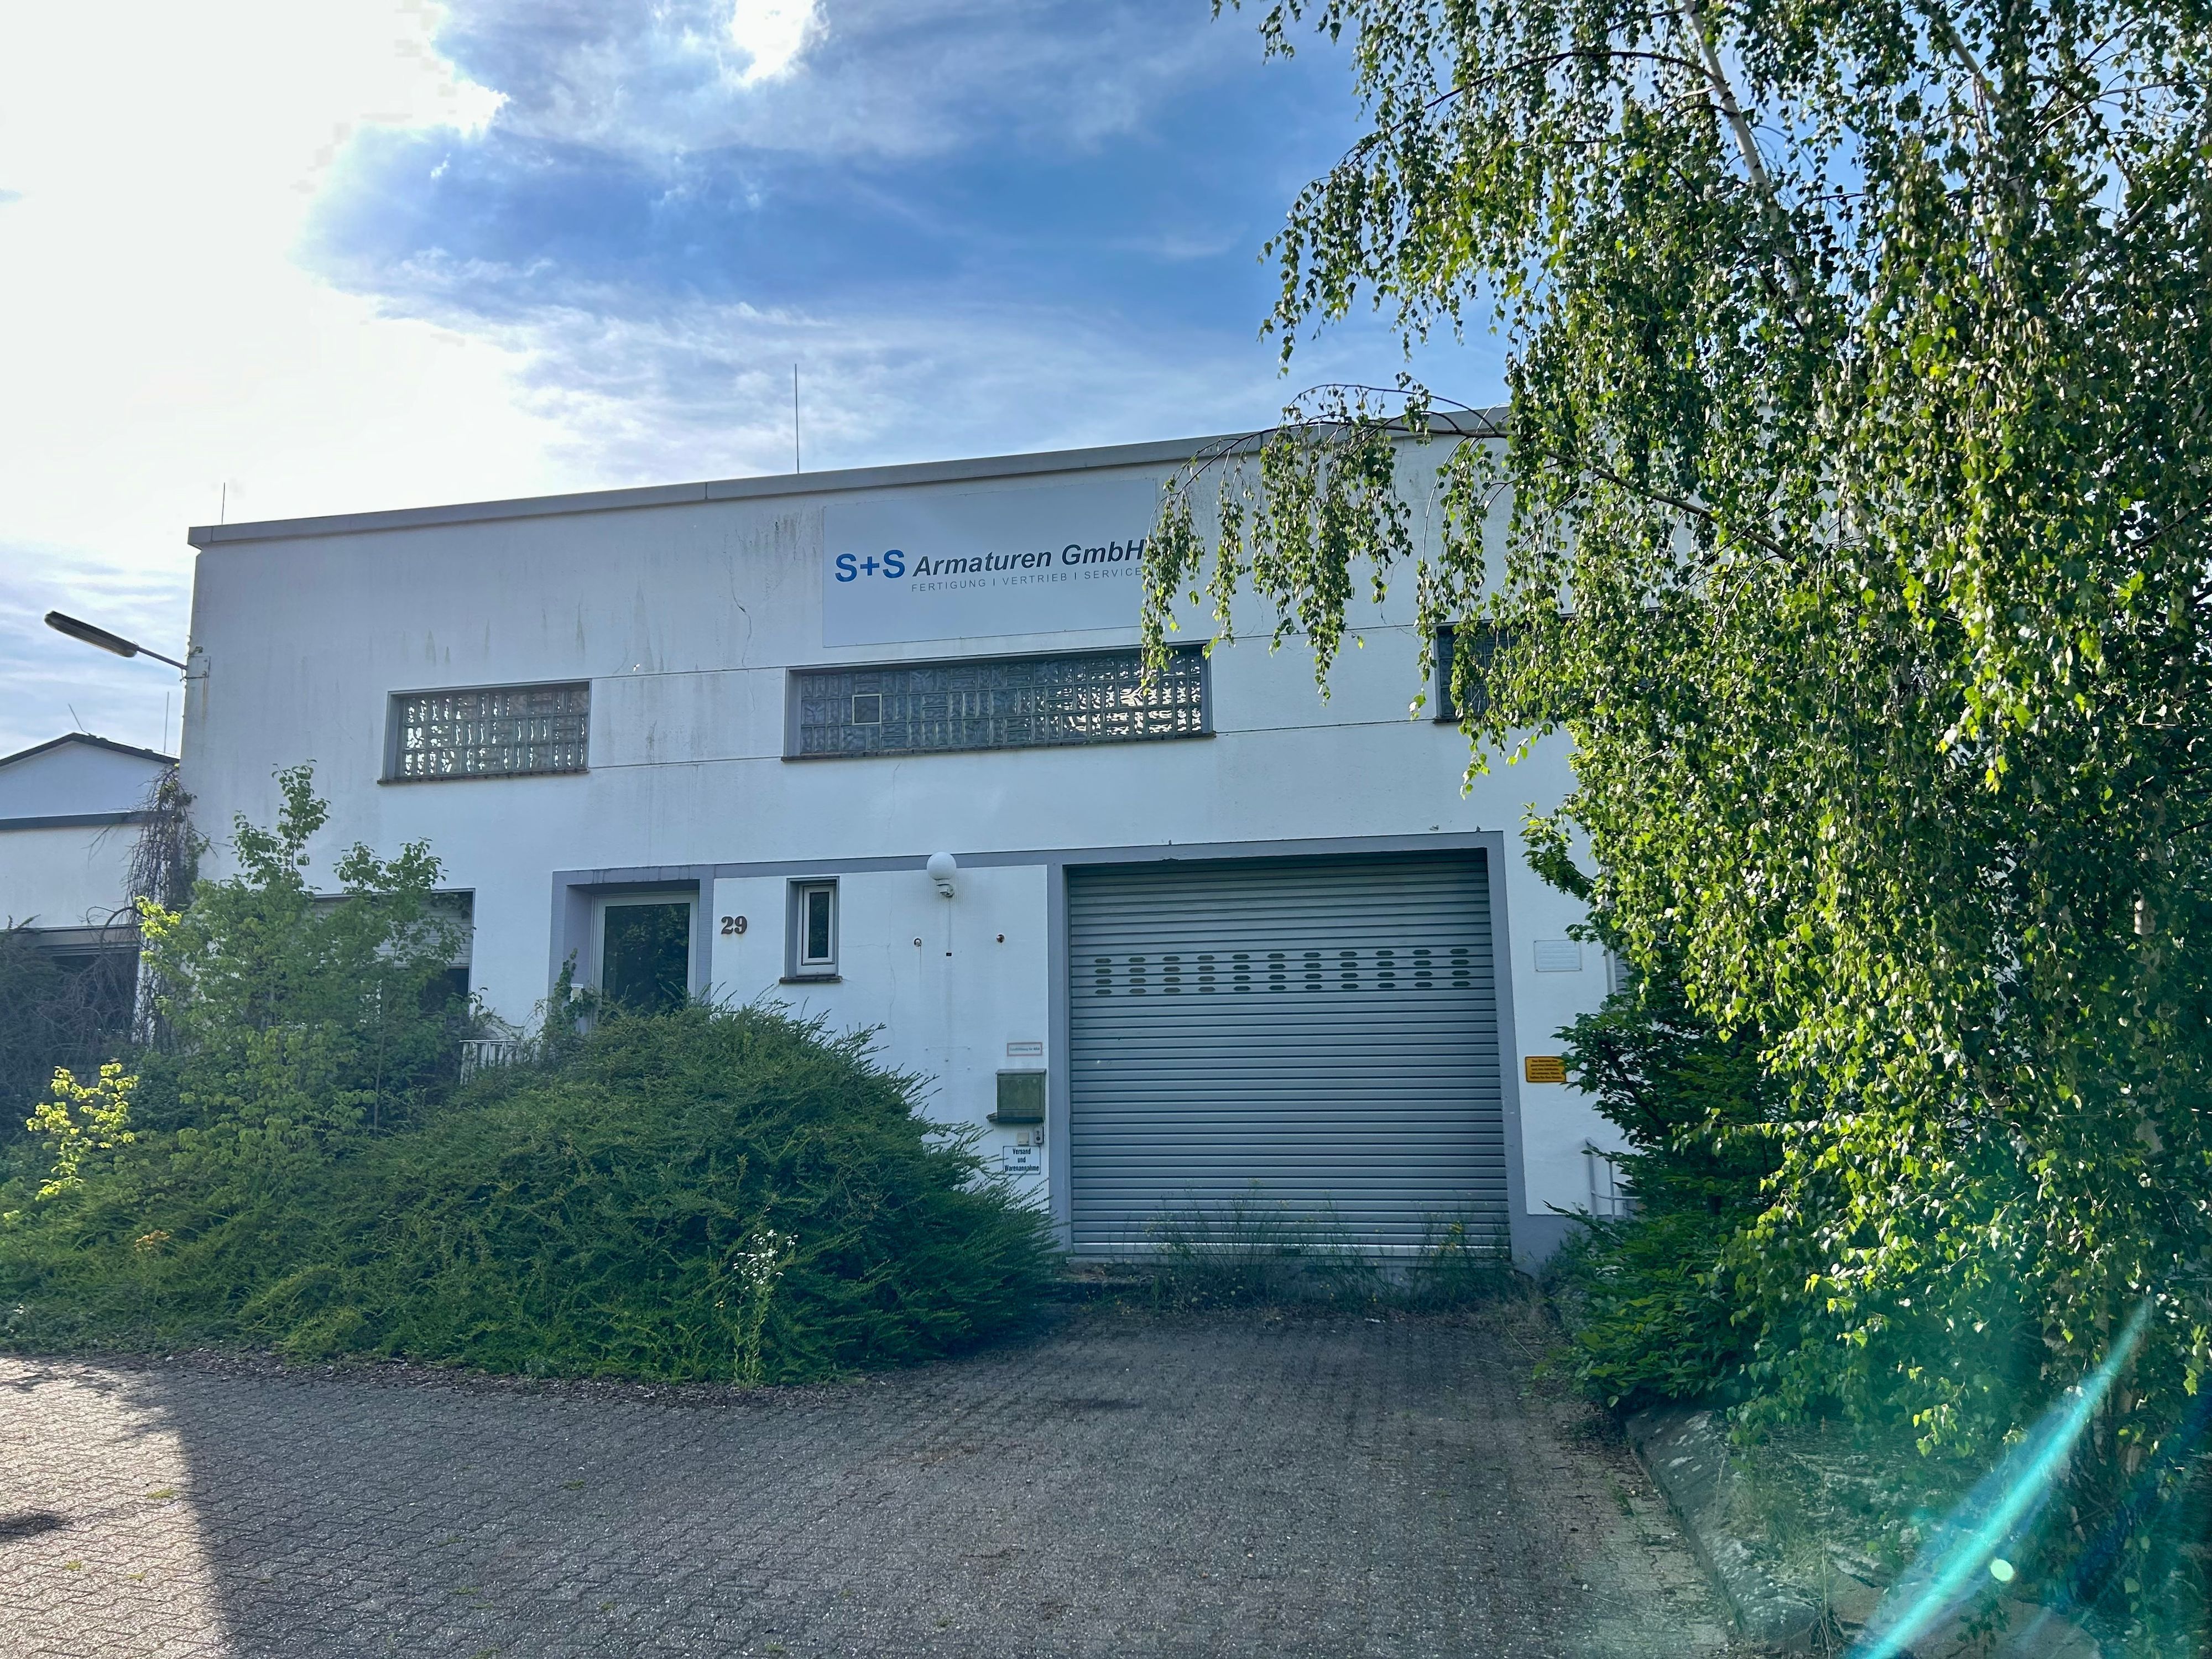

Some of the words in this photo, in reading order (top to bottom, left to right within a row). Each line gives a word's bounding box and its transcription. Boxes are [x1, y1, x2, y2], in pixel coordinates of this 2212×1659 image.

[835, 549, 905, 582] S+S
[912, 551, 1052, 577] Armaturen
[1062, 539, 1145, 565] GmbH
[911, 579, 986, 592] FERTIGUNG
[1002, 573, 1067, 585] VERTRIEB
[1084, 567, 1141, 580] SERVICE
[721, 915, 748, 935] 29
